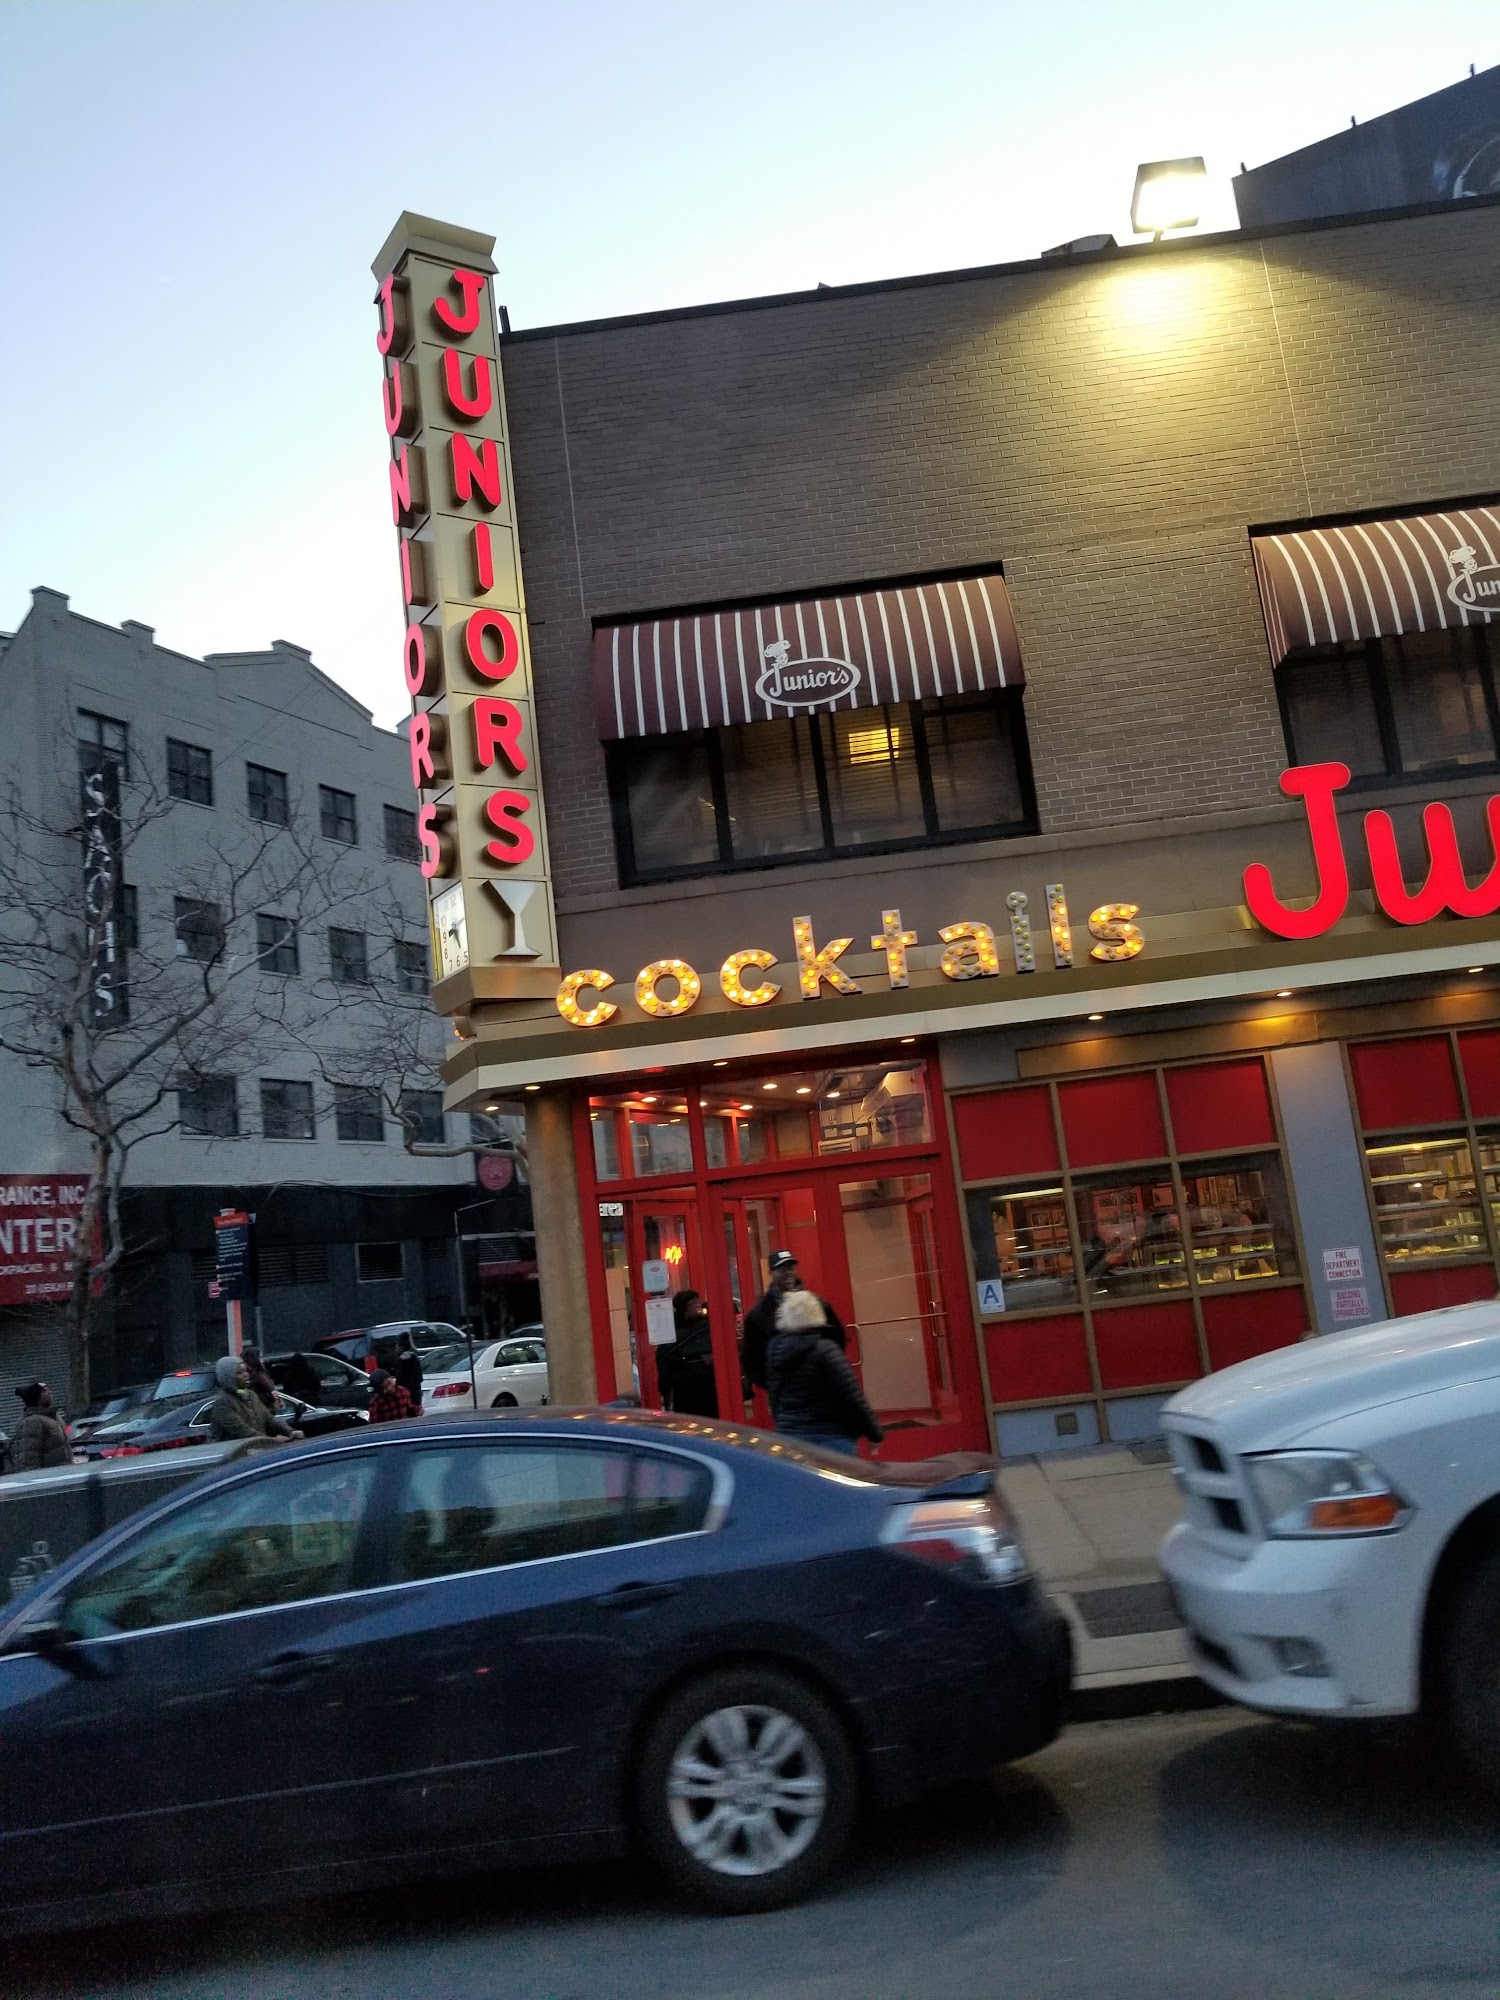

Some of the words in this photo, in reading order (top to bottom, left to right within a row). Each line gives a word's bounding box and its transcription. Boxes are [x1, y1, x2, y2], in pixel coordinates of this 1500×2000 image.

[377, 272, 441, 878] JUNIORS
[434, 269, 535, 863] JUNIORS
[769, 662, 850, 697] Junior's
[555, 883, 1146, 1027] cocktails
[0, 1217, 79, 1254] NTER
[1326, 1259, 1360, 1270] DEPARTMENT
[1335, 1251, 1348, 1259] FIRE
[1328, 1268, 1361, 1279] CONNECTION
[983, 1284, 1000, 1305] A
